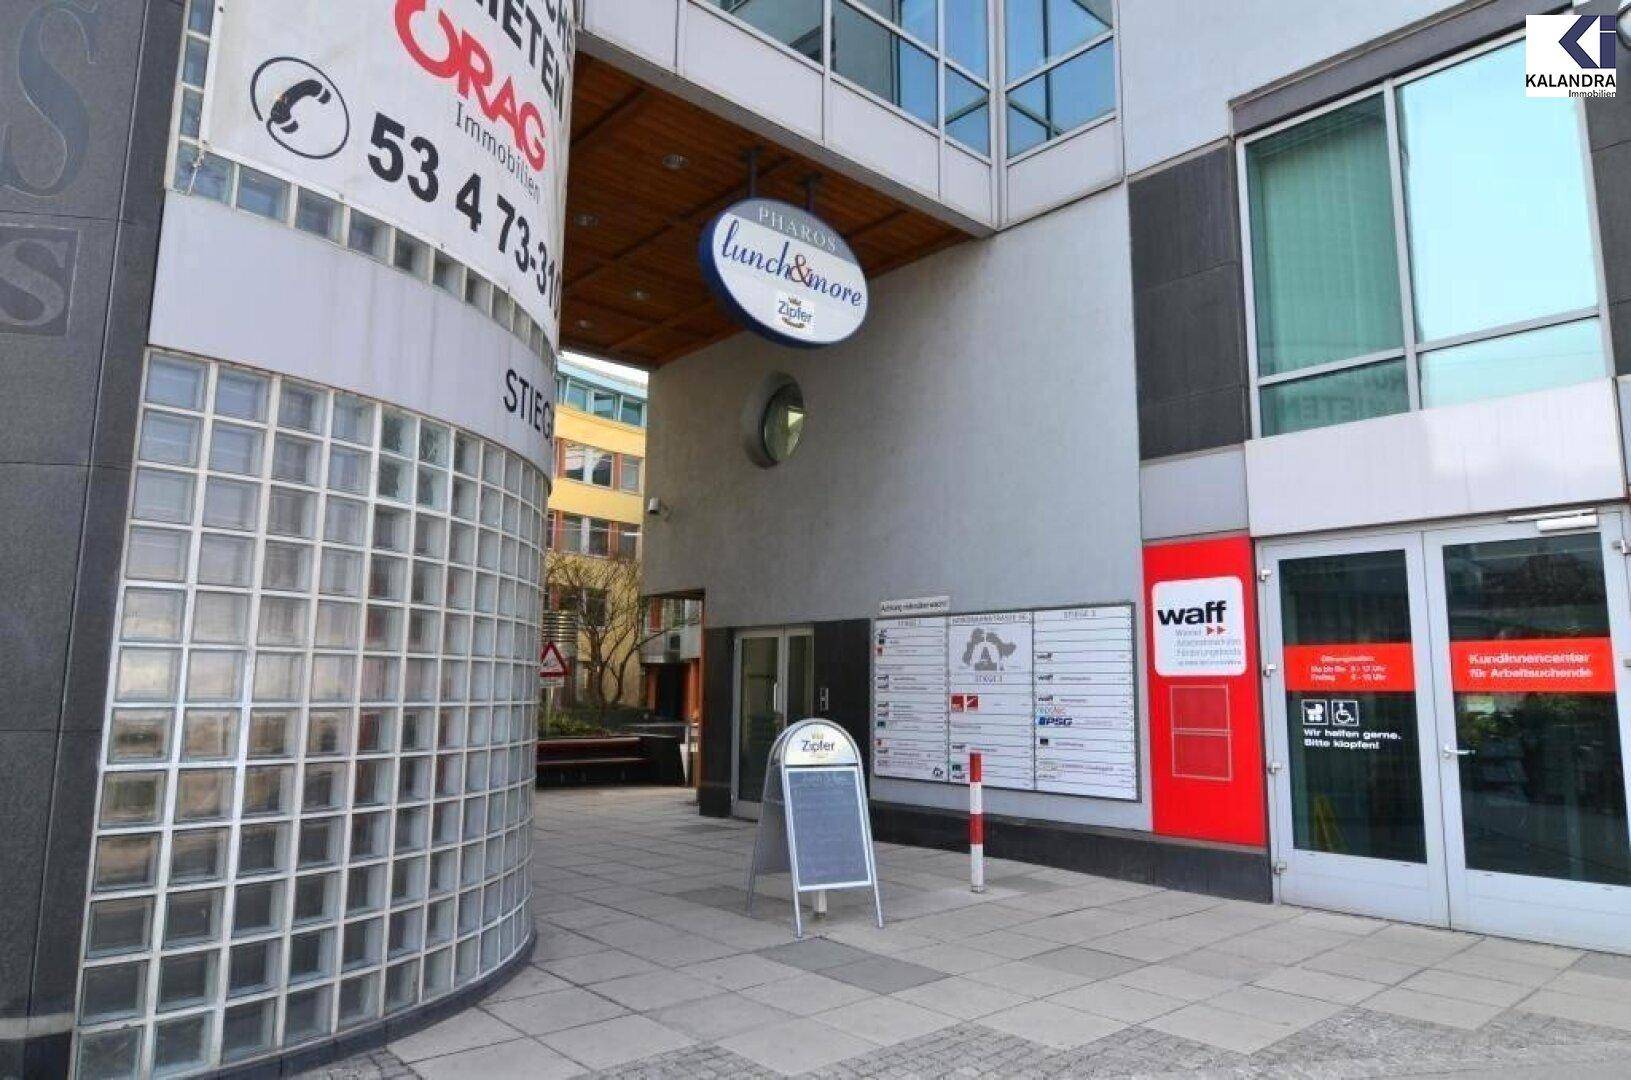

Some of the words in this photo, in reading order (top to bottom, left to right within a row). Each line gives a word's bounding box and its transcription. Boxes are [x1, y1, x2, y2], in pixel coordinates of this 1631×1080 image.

[395, 0, 546, 172] ORAG
[456, 101, 541, 203] Immobilien
[367, 112, 439, 203] 53
[455, 173, 482, 233] 4
[758, 206, 838, 251] PHAROS
[779, 300, 813, 322] Zipfer
[1157, 600, 1227, 625] waff
[802, 738, 834, 753] Zipfer
[1304, 729, 1321, 737] Wir
[1304, 739, 1330, 748] Bitte
